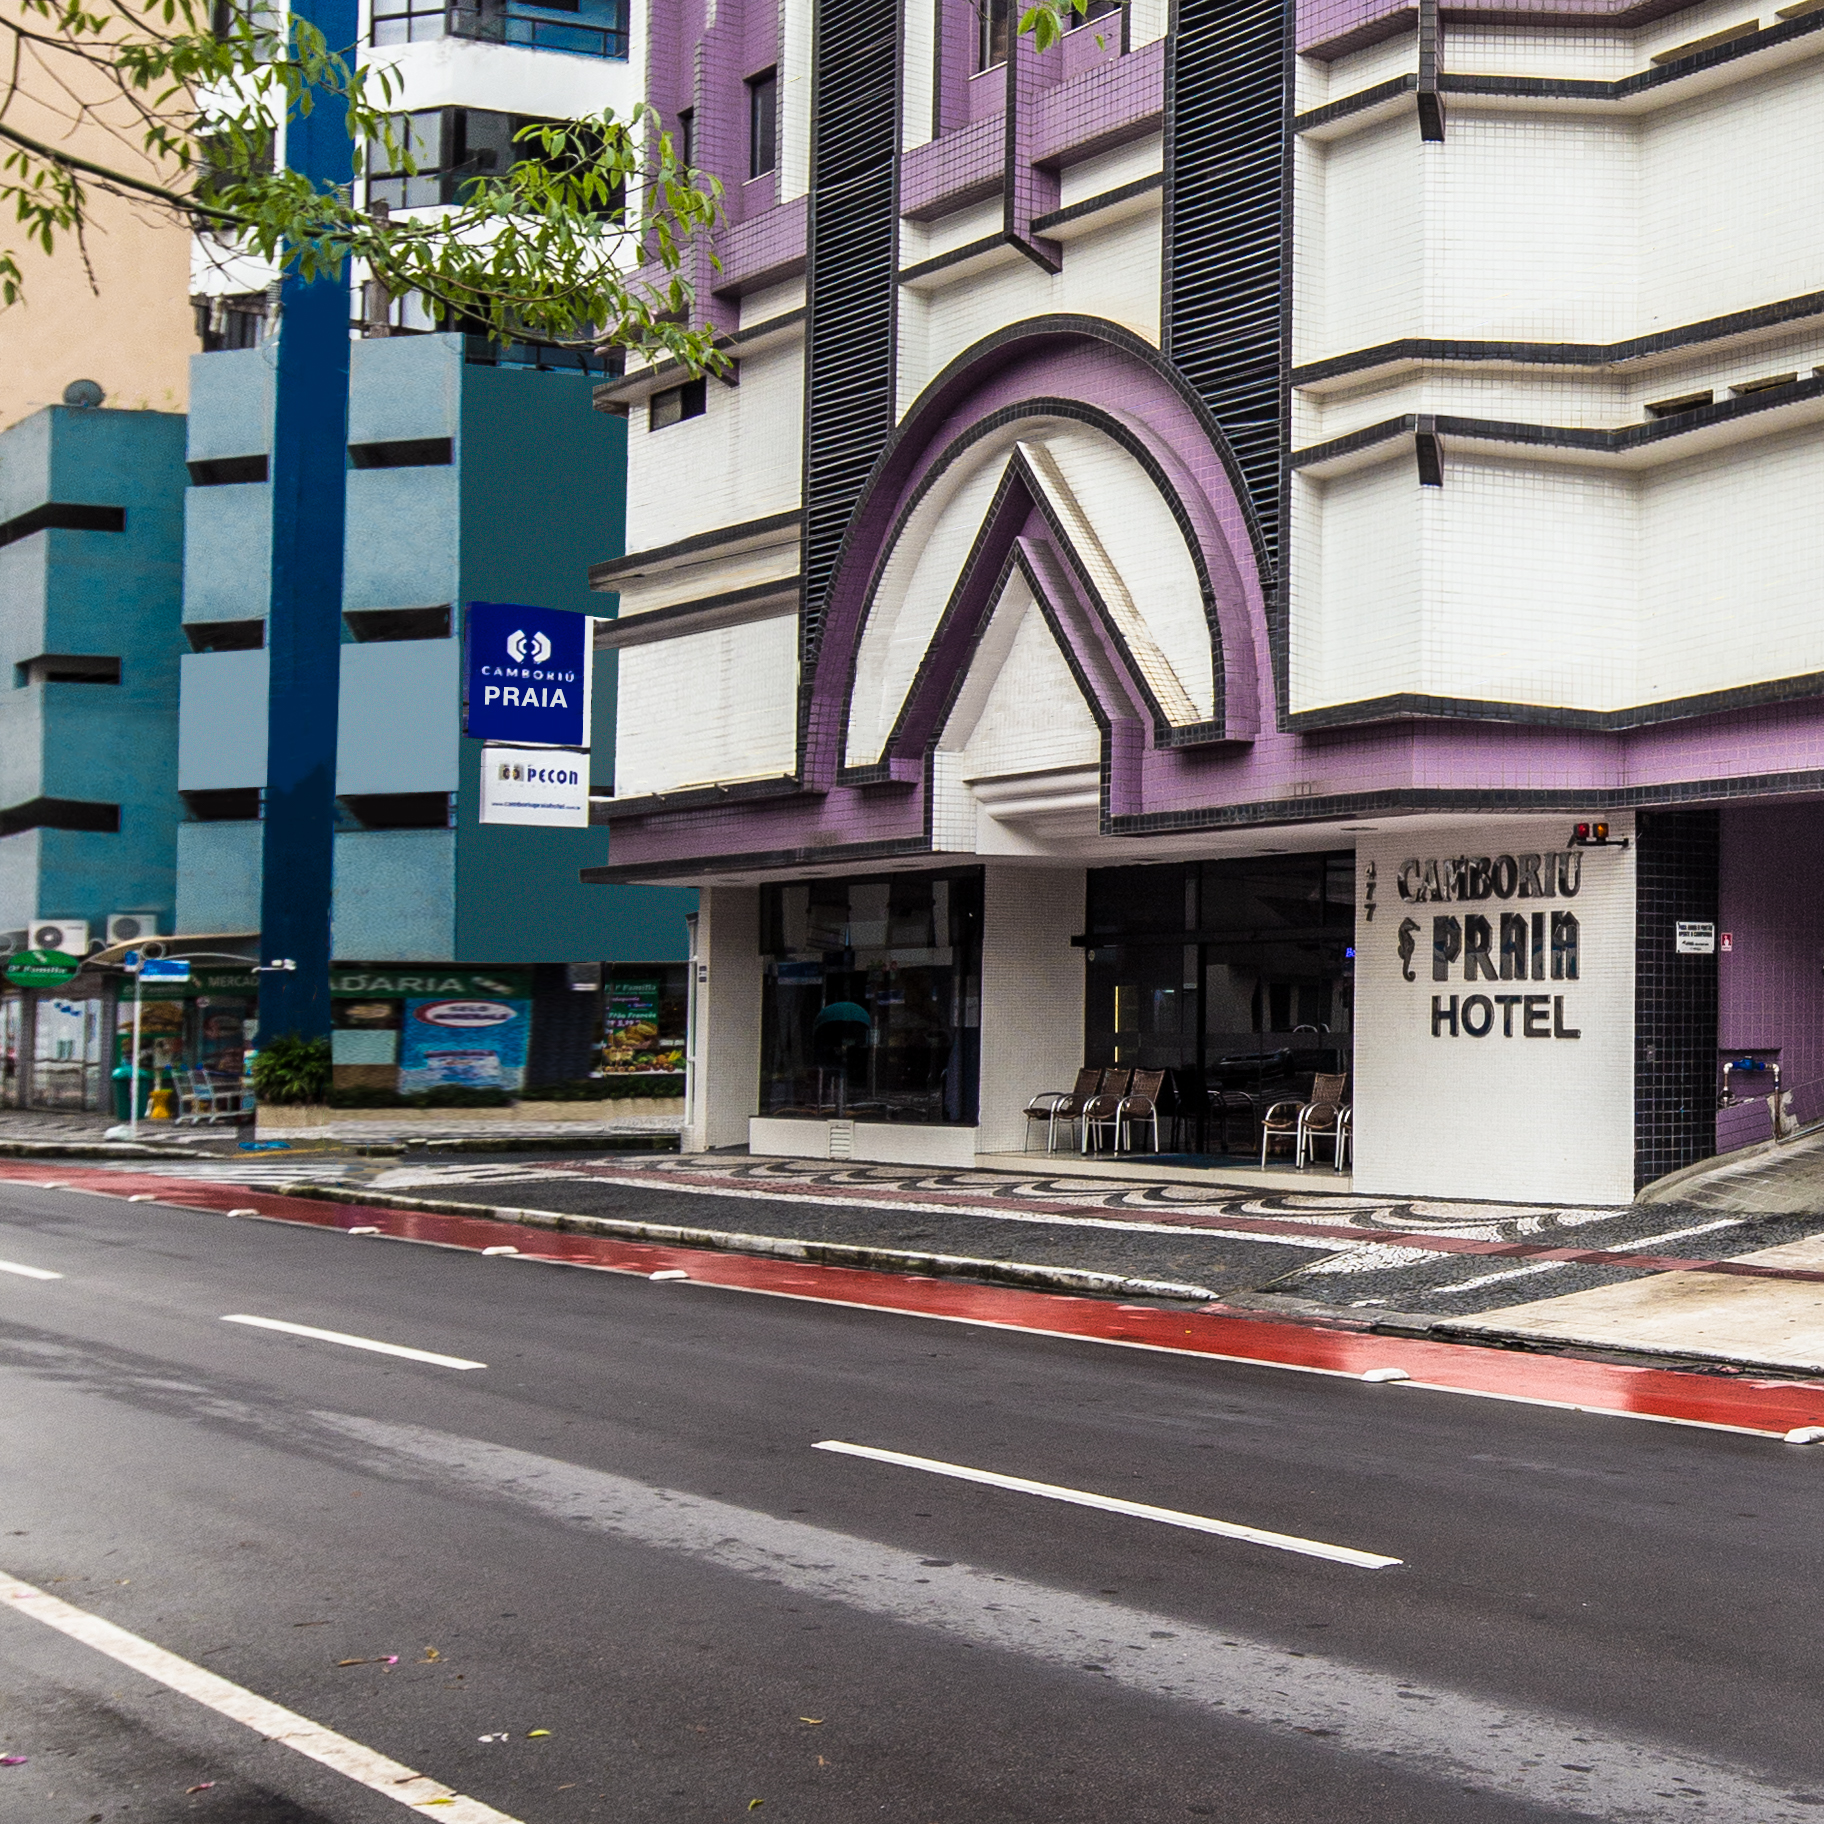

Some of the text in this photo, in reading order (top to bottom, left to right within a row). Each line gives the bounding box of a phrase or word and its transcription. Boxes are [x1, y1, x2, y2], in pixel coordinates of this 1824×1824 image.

[481, 665, 575, 683] CAMBORIÚ
[484, 685, 568, 709] PRAIA
[1432, 910, 1580, 981] PRAIA
[208, 976, 259, 987] MERCAD
[1431, 994, 1581, 1038] HOTEL
